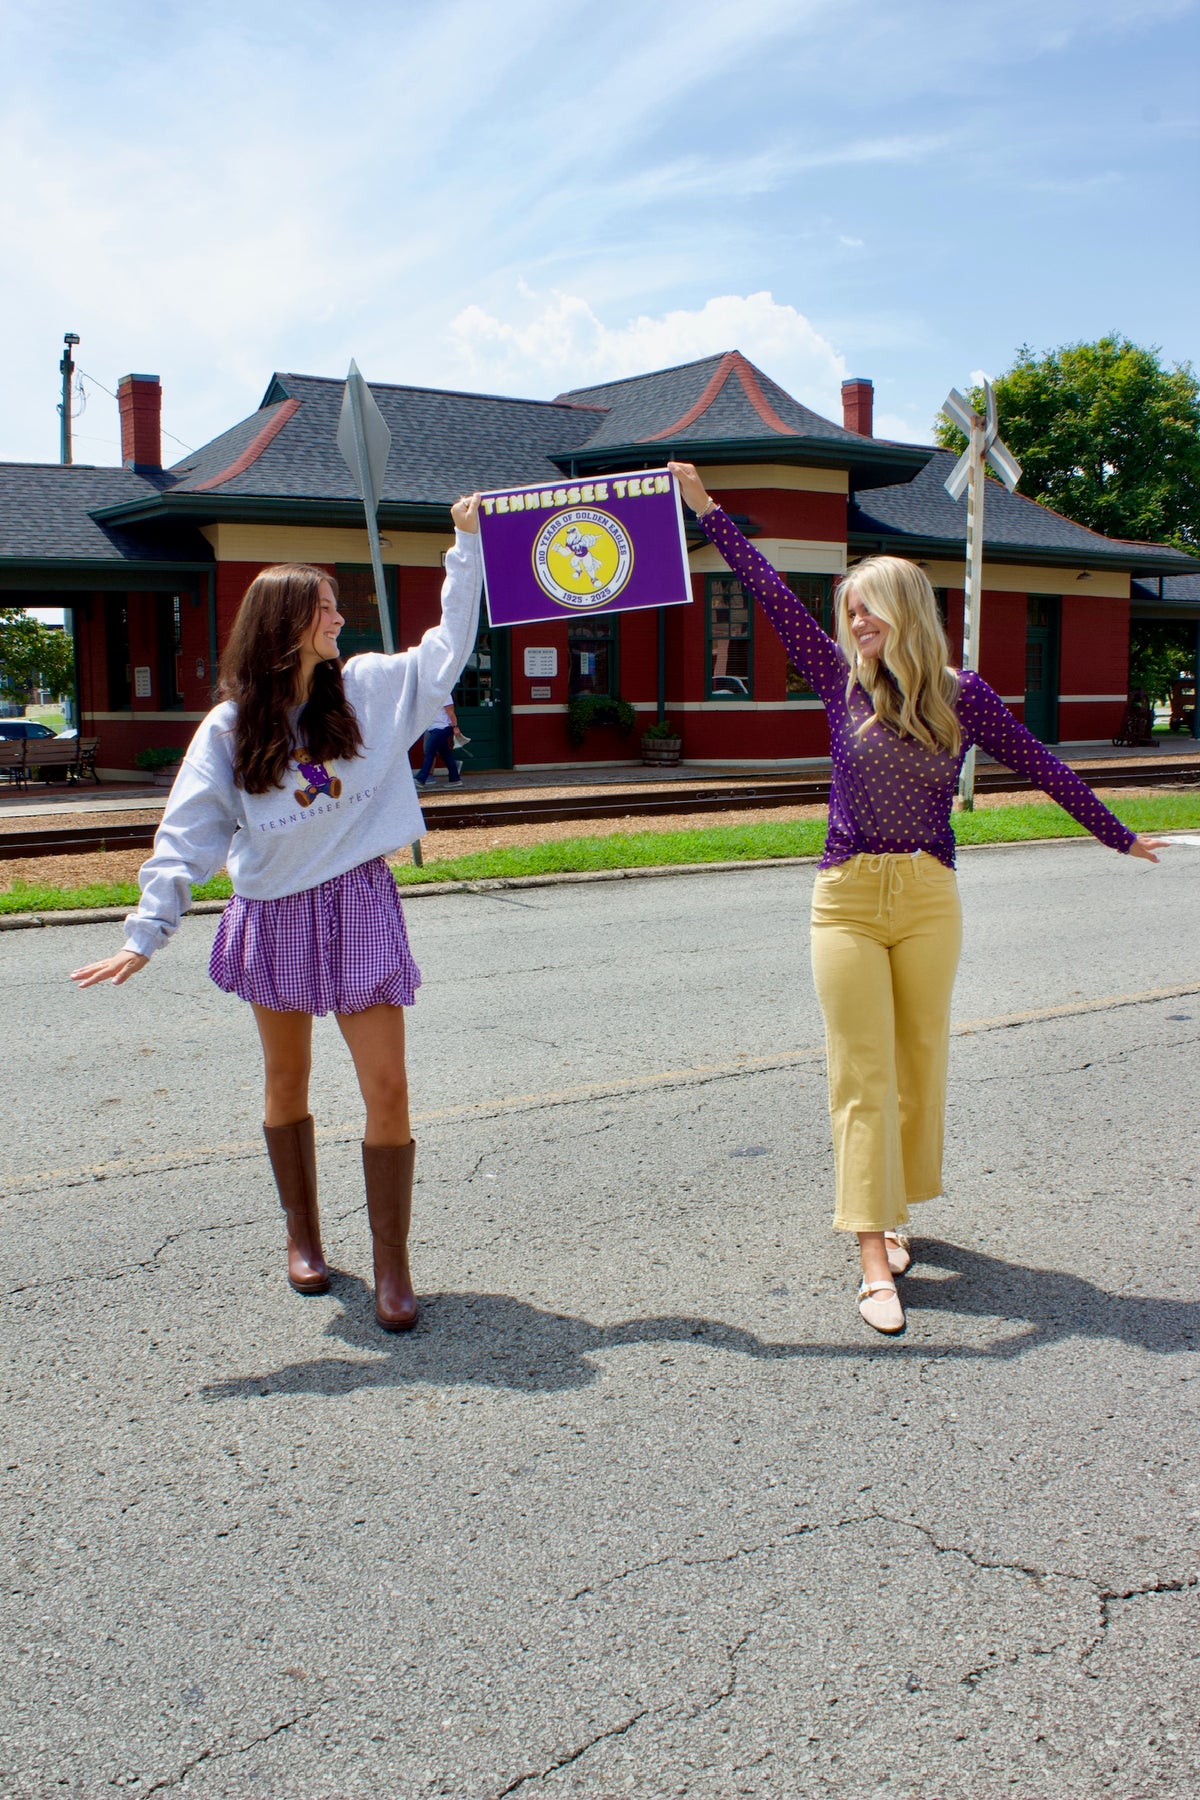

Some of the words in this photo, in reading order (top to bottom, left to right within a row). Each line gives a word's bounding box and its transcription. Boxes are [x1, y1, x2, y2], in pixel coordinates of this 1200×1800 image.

[481, 483, 609, 516] TENNESSEE
[613, 475, 671, 499] TECH
[562, 513, 573, 523] OF
[575, 512, 609, 526] GOLDEN
[540, 520, 562, 547] YEARS
[608, 523, 627, 556] EAGLES
[538, 550, 546, 565] 100
[562, 592, 583, 604] 1925
[590, 587, 612, 603] 2025
[260, 801, 341, 832] TENNESSEE
